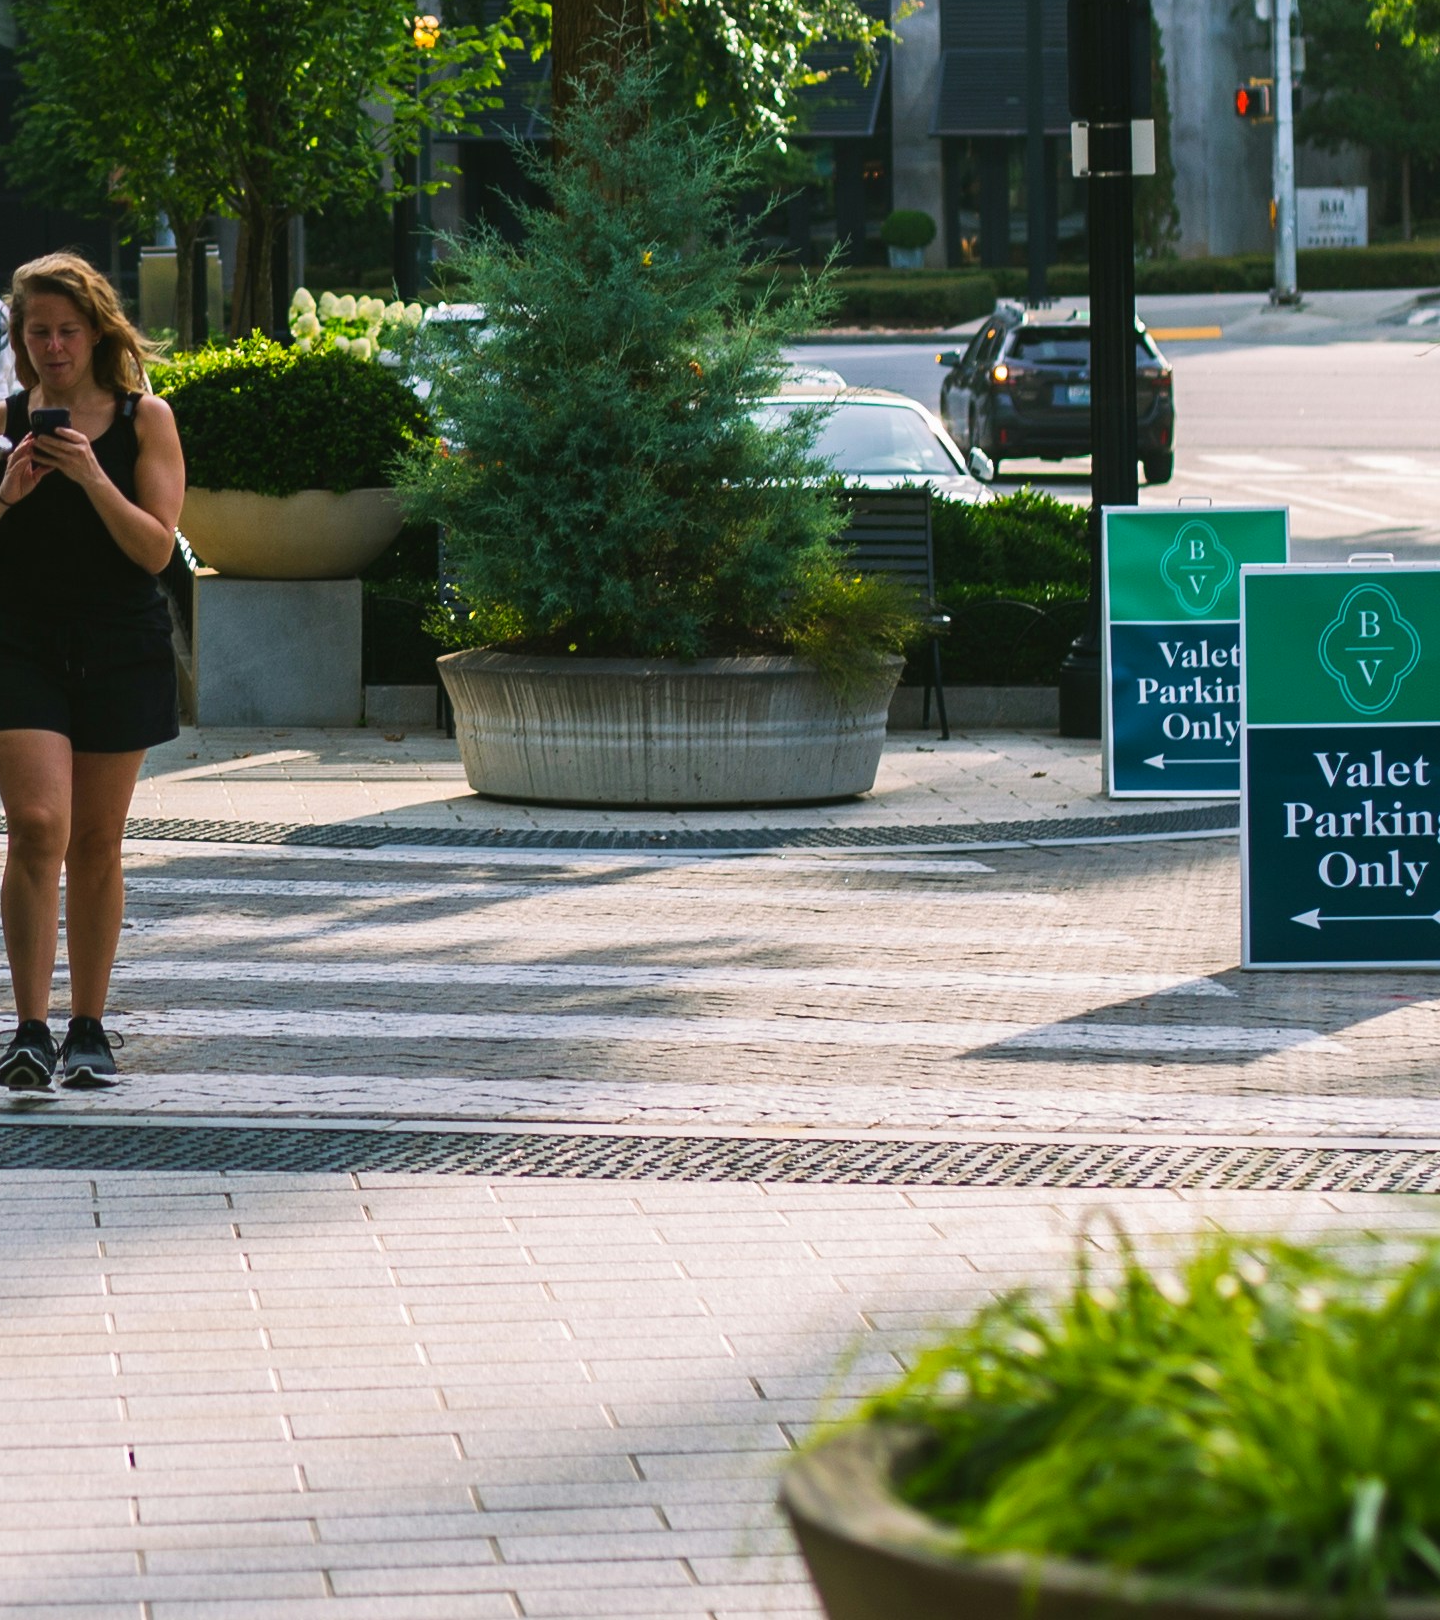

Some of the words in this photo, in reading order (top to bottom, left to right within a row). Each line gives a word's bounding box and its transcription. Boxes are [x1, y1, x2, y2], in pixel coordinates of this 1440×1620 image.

[1189, 539, 1206, 561] B
[1189, 574, 1207, 596] V
[1358, 610, 1382, 639] B
[1157, 639, 1240, 669] Valet
[1357, 659, 1384, 687] V
[1136, 675, 1240, 705] Parkin
[1162, 711, 1241, 747] Only
[1312, 749, 1432, 789] Valet
[1318, 848, 1430, 897] Only
